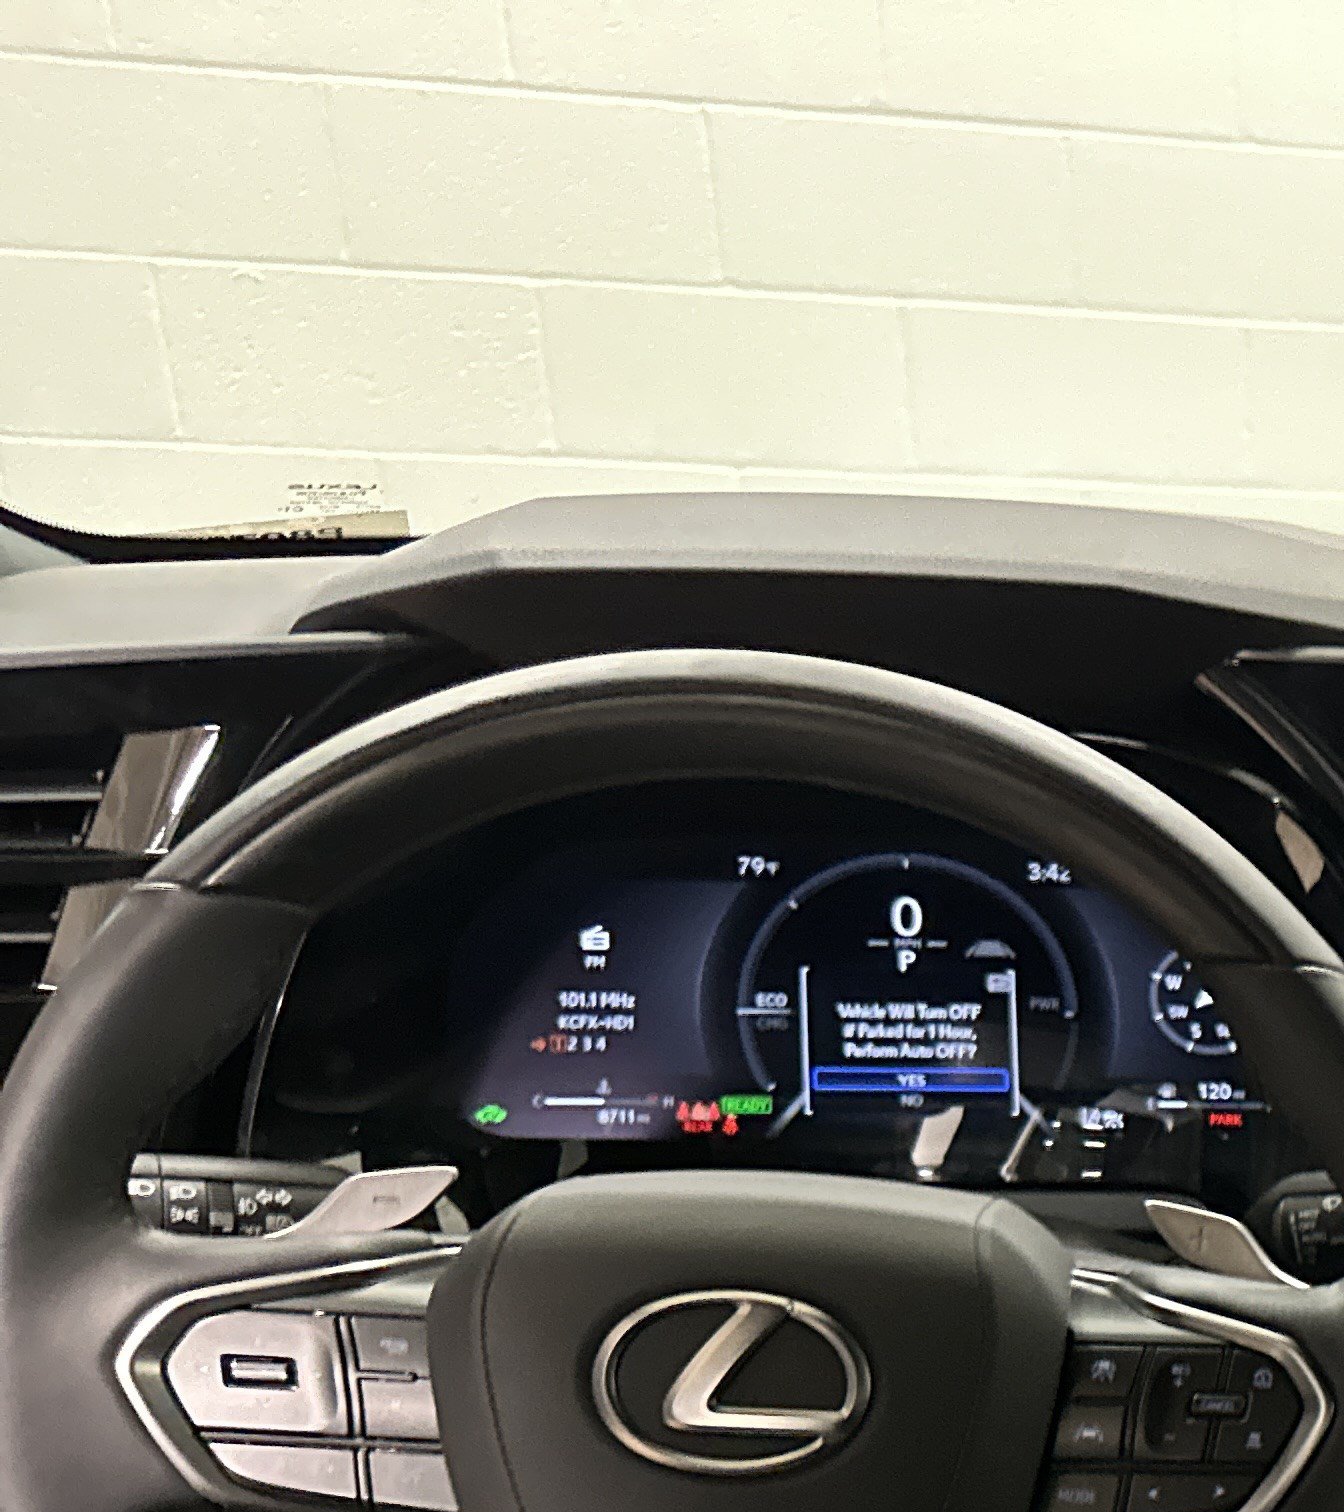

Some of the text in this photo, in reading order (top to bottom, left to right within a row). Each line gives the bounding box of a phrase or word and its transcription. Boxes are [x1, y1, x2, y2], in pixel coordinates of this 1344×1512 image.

[890, 895, 924, 938] 0
[897, 949, 918, 974] P
[1163, 974, 1184, 991] W
[754, 990, 789, 1009] ECO
[835, 1002, 982, 1021] Vehicle Will Turn OFF
[857, 1022, 905, 1040] Parked
[905, 1022, 927, 1040] for
[842, 1041, 899, 1058] Perform
[899, 1041, 935, 1059] Auto
[897, 1073, 927, 1088] YES
[1197, 1085, 1233, 1101] 120
